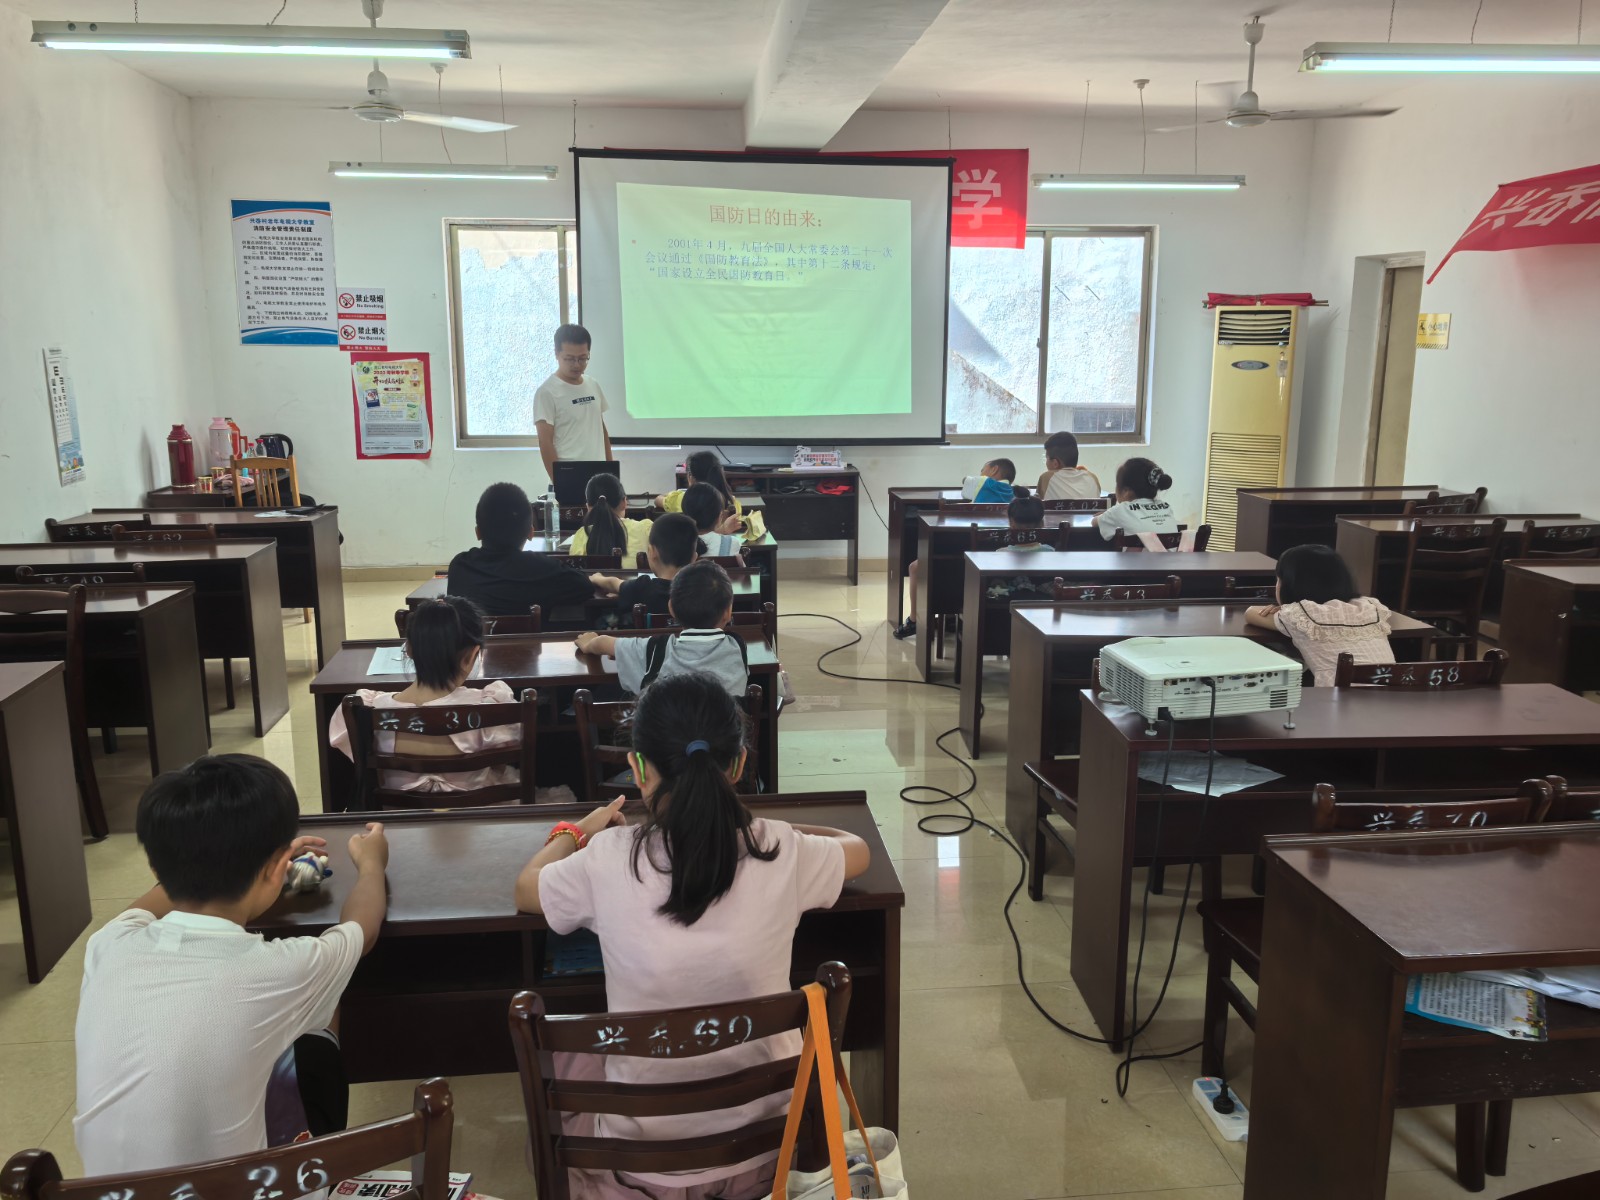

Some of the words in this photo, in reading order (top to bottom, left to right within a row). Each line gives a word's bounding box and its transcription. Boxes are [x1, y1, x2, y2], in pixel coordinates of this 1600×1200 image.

[952, 169, 1003, 230] 学
[355, 294, 384, 303] 禁止吸烟
[357, 327, 385, 335] 禁止烟火
[1017, 531, 1037, 542] 65
[1123, 589, 1146, 600] 13
[1428, 666, 1460, 686] 58
[445, 711, 482, 730] 30
[694, 1015, 753, 1047] 60
[248, 1158, 329, 1200] 26
